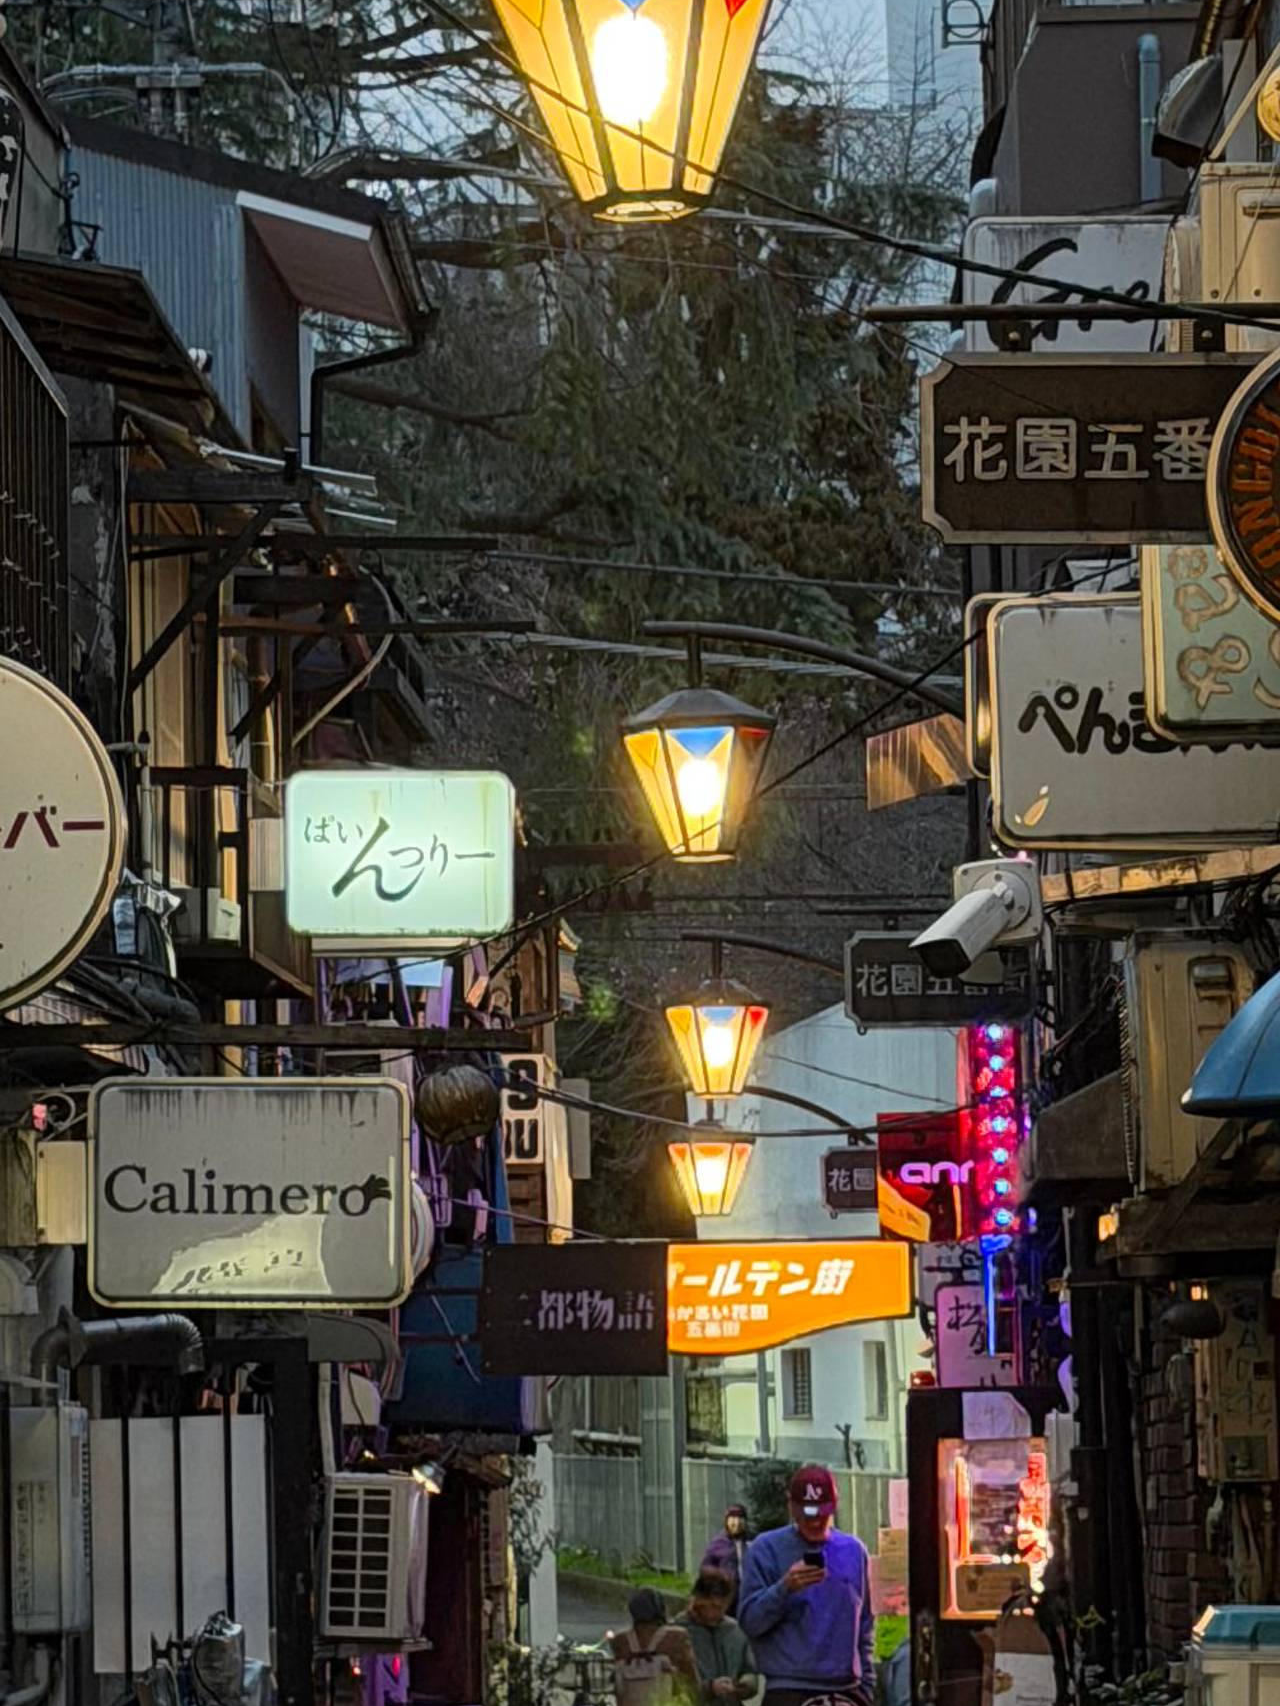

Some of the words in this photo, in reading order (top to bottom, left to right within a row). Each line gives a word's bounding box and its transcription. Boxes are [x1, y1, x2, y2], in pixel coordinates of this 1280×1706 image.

[304, 815, 495, 901] ぱいんつりー
[105, 1164, 380, 1216] Calimero
